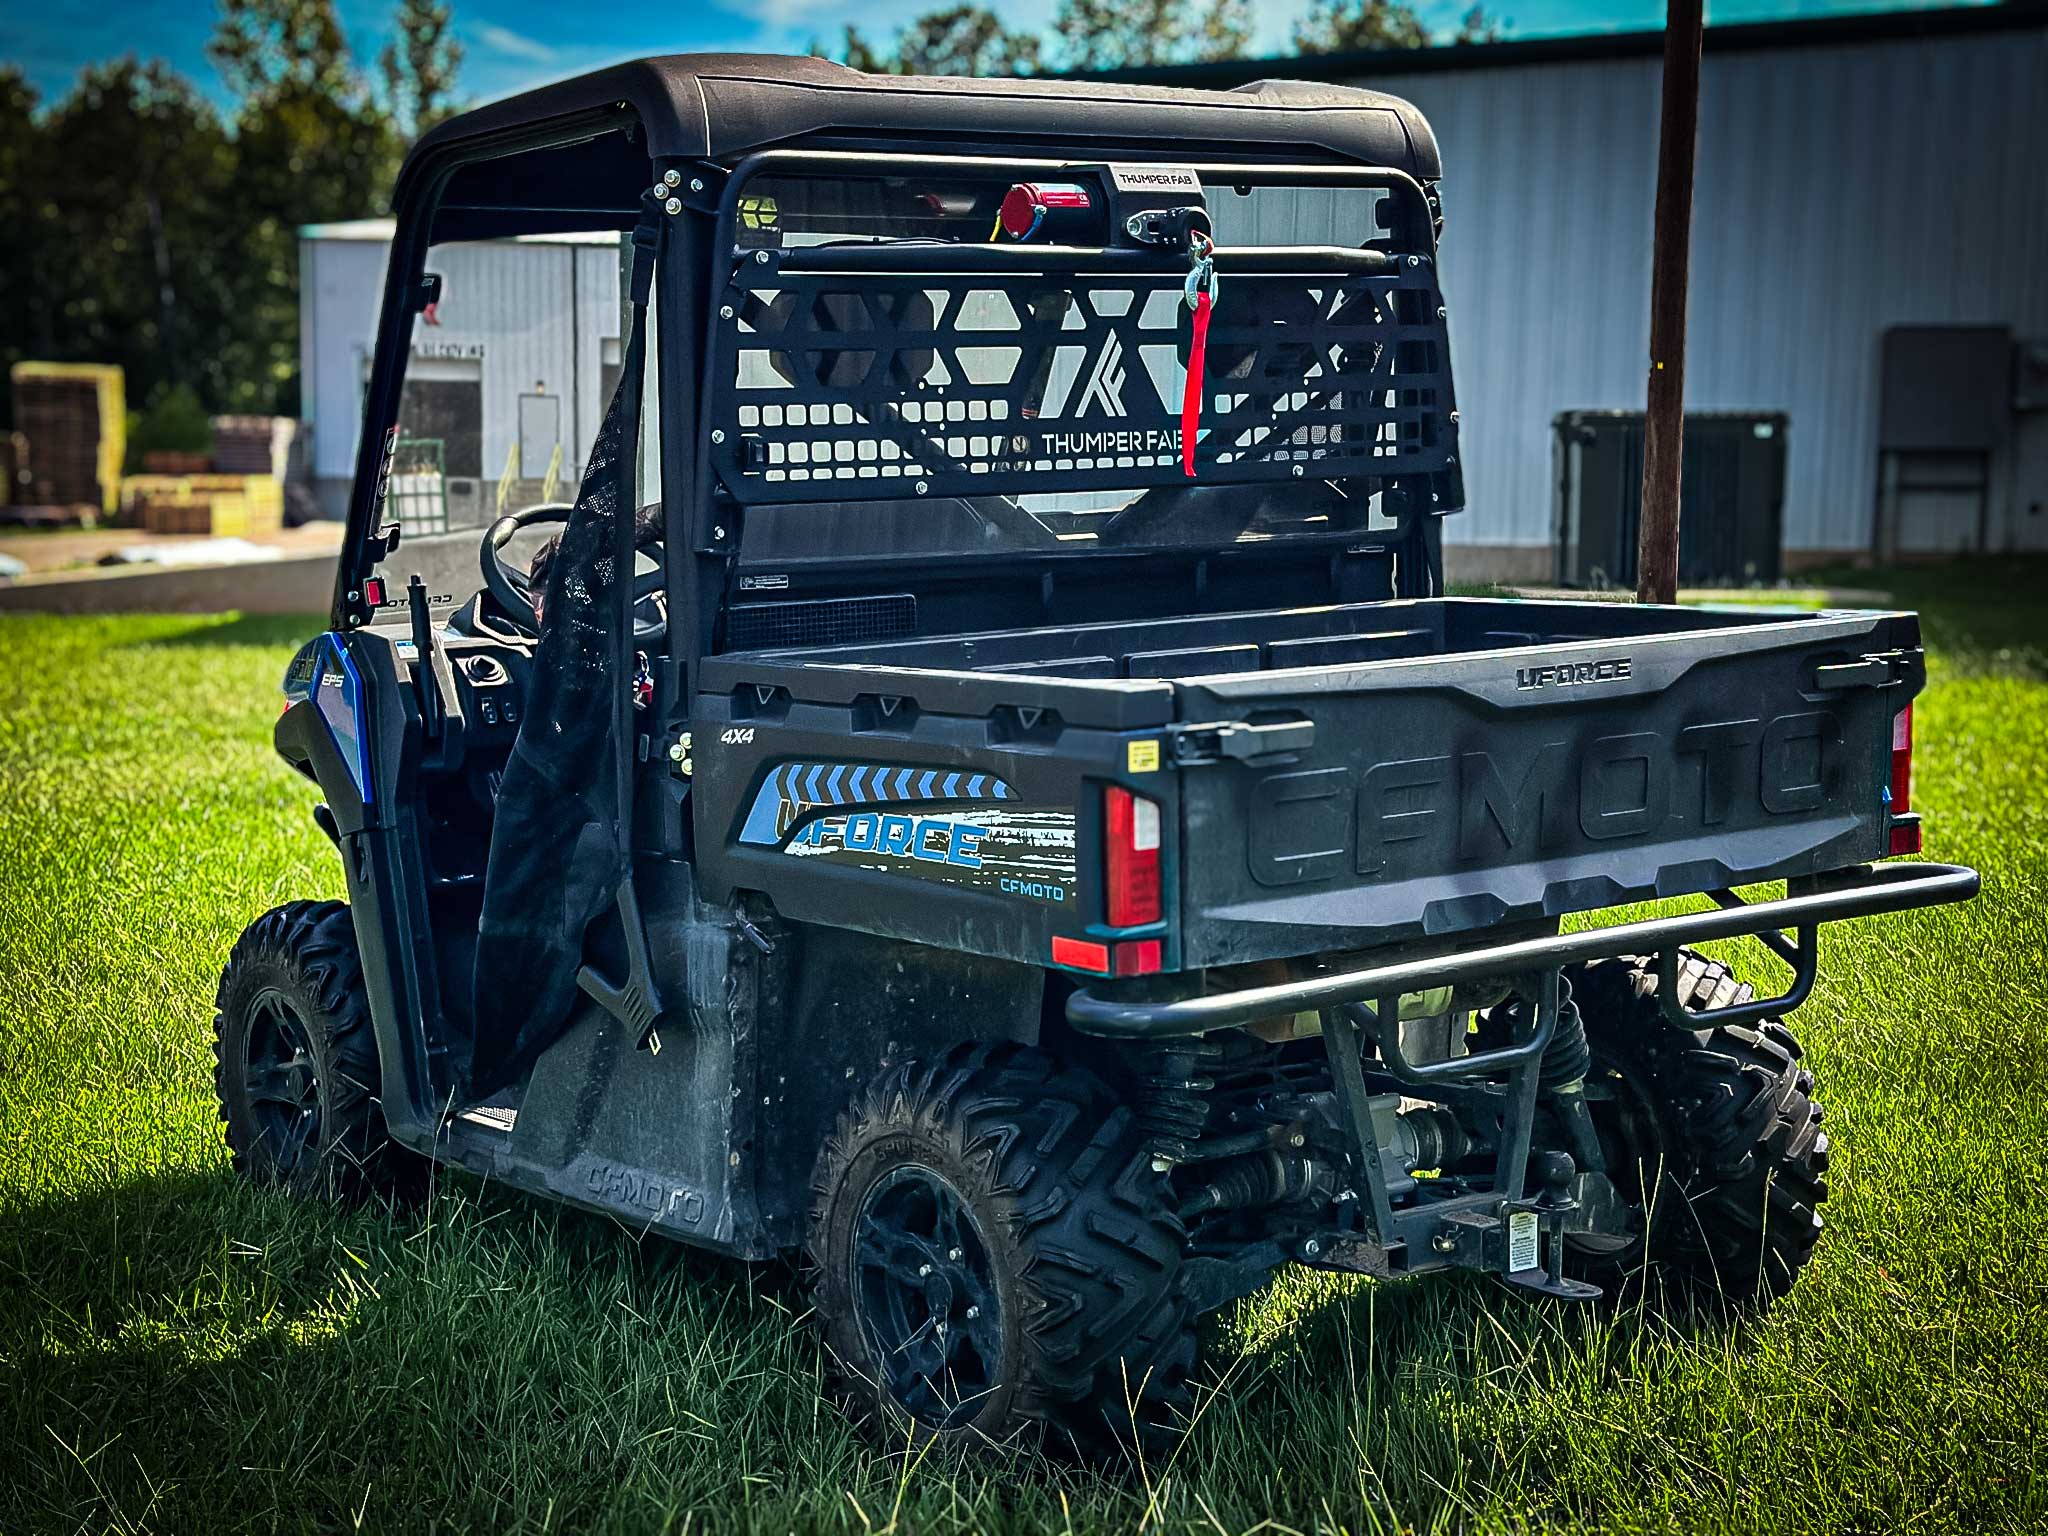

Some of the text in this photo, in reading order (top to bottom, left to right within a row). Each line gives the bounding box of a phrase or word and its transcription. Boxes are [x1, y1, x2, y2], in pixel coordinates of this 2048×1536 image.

[1119, 173, 1193, 185] THUMPER FAB
[1041, 430, 1143, 454] THUMPER
[321, 673, 345, 688] EPS
[1515, 656, 1633, 691] UFORCE
[720, 727, 755, 745] 4X4
[1248, 710, 1844, 887] CFMOTO
[1000, 878, 1064, 901] CFMOTO
[586, 1166, 705, 1224] CFMOTO
